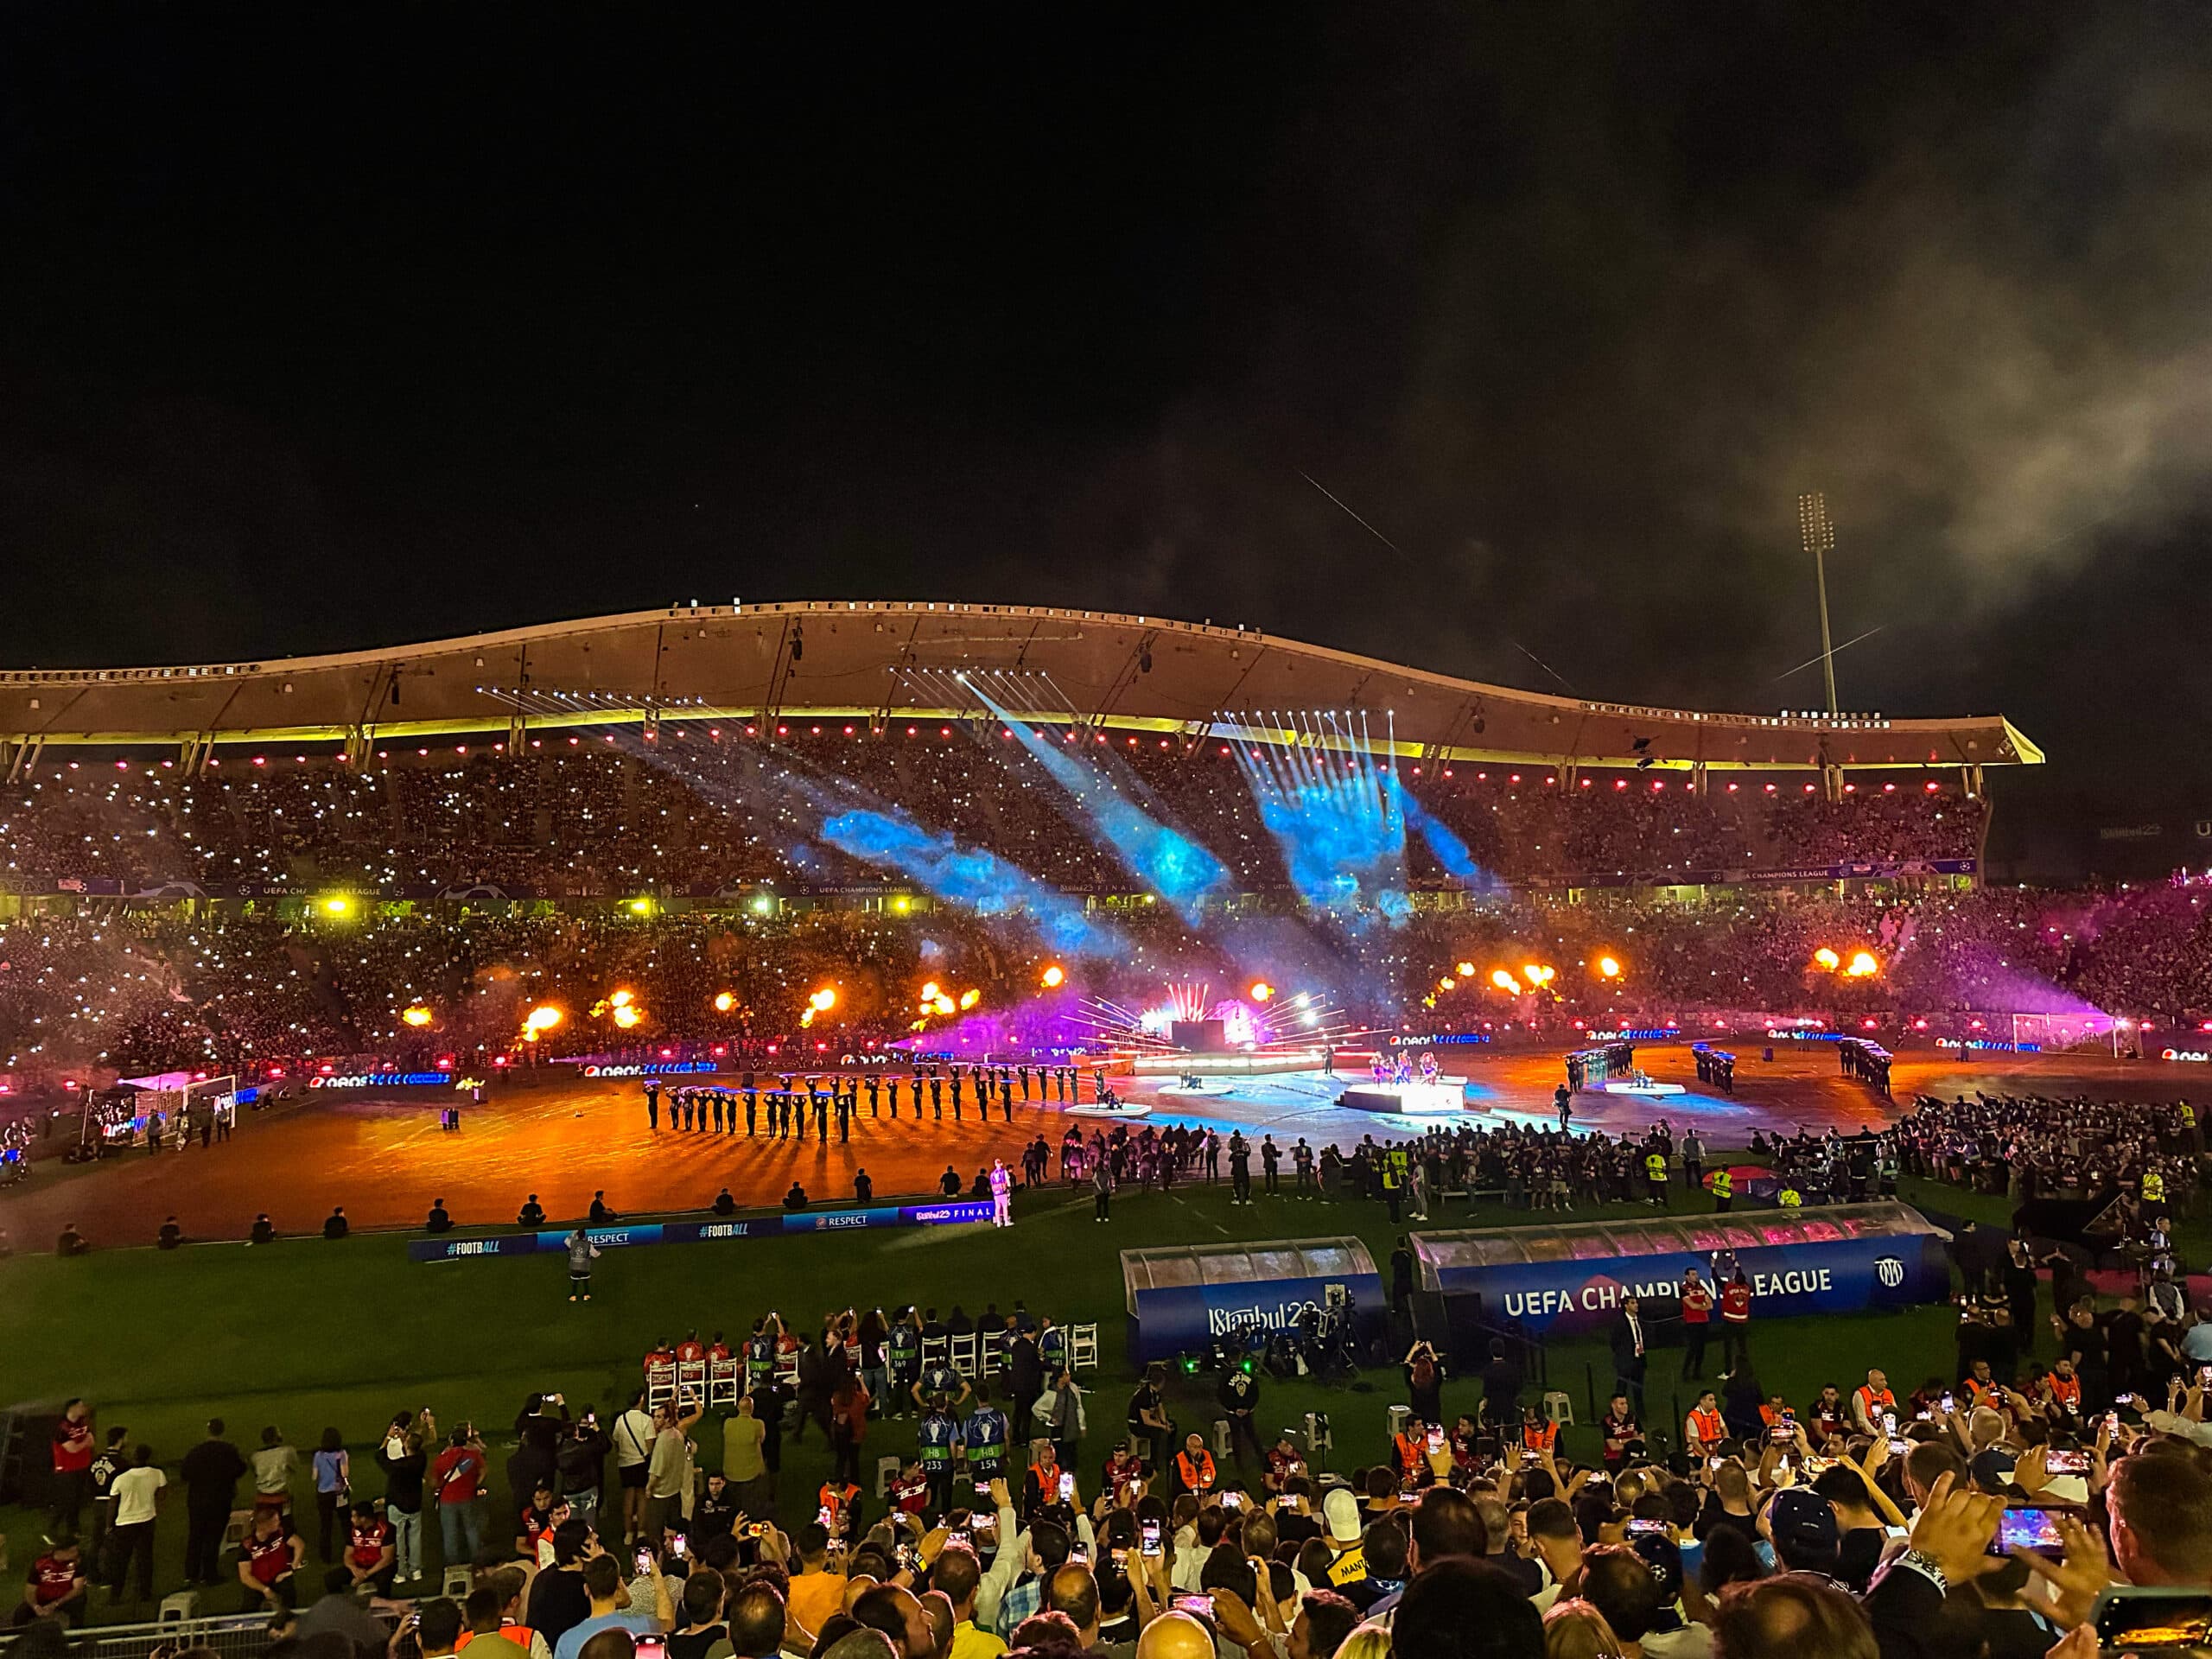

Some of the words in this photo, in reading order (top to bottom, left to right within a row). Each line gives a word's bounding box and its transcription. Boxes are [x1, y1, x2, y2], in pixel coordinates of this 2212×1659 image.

[1752, 871, 1796, 880] CHAMPIONS
[264, 887, 288, 895] UEFA
[290, 887, 344, 895] CHIONS
[954, 1207, 991, 1217] FINAL
[830, 1216, 868, 1226] RESPECT
[699, 1223, 748, 1238] #FOOTBALL
[587, 1233, 630, 1244] RESPECT
[446, 1240, 499, 1255] #FOOTBALL
[1505, 1289, 1575, 1317] UEFA
[1581, 1277, 1729, 1311] CHAMPIN
[1750, 1268, 1833, 1298] EAGUE
[928, 1448, 940, 1458] HB
[982, 1447, 995, 1457] HB
[926, 1460, 943, 1471] 233
[981, 1459, 997, 1470] 154
